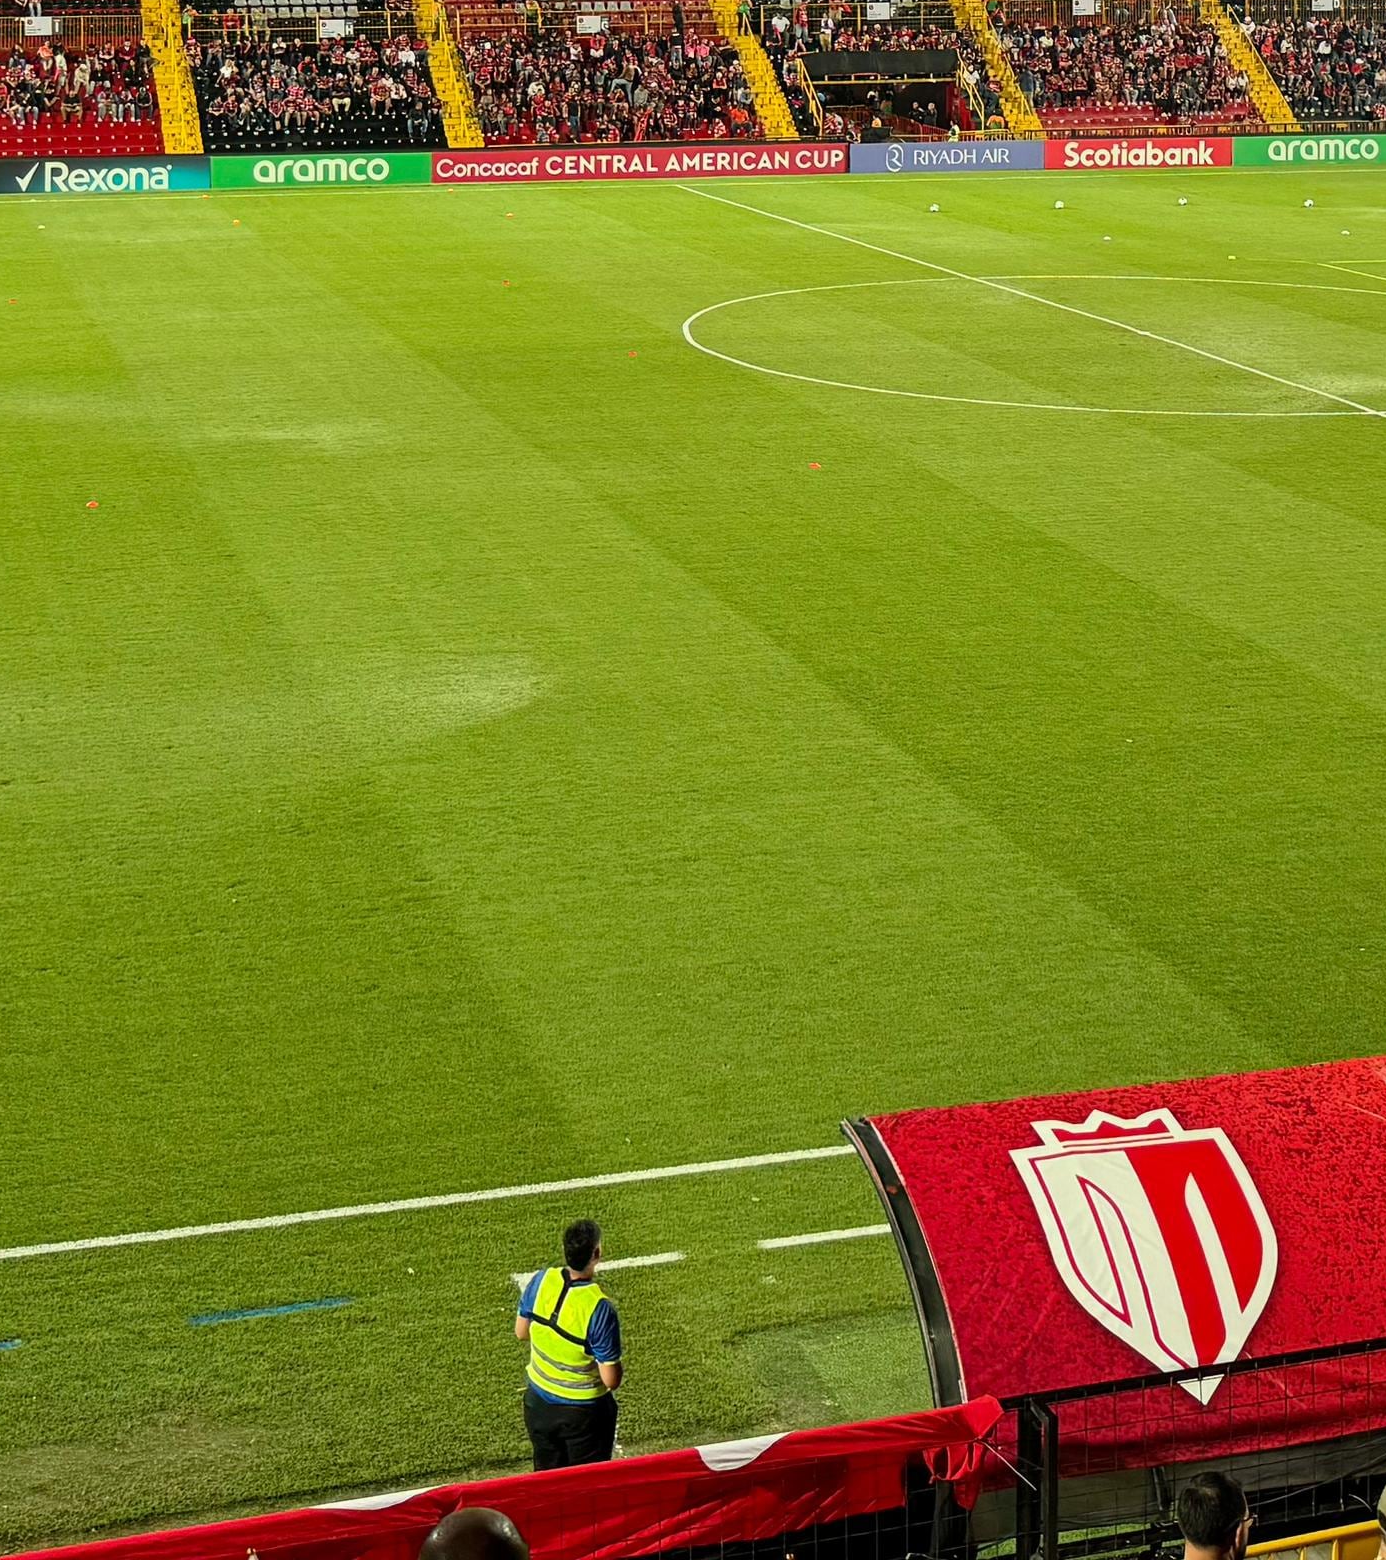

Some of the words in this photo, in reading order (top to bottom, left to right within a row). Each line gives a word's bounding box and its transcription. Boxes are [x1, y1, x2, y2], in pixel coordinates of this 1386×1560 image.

[913, 148, 977, 166] RIYADH
[980, 148, 1010, 165] AIR
[1063, 141, 1215, 168] Scotiabank
[1267, 138, 1380, 162] aramco
[253, 158, 390, 184] aramco
[436, 158, 539, 179] Concacaf
[545, 154, 658, 175] CENTRAL
[665, 151, 791, 172] AMERICAN
[794, 148, 845, 170] CUP
[44, 162, 170, 193] Rexona
